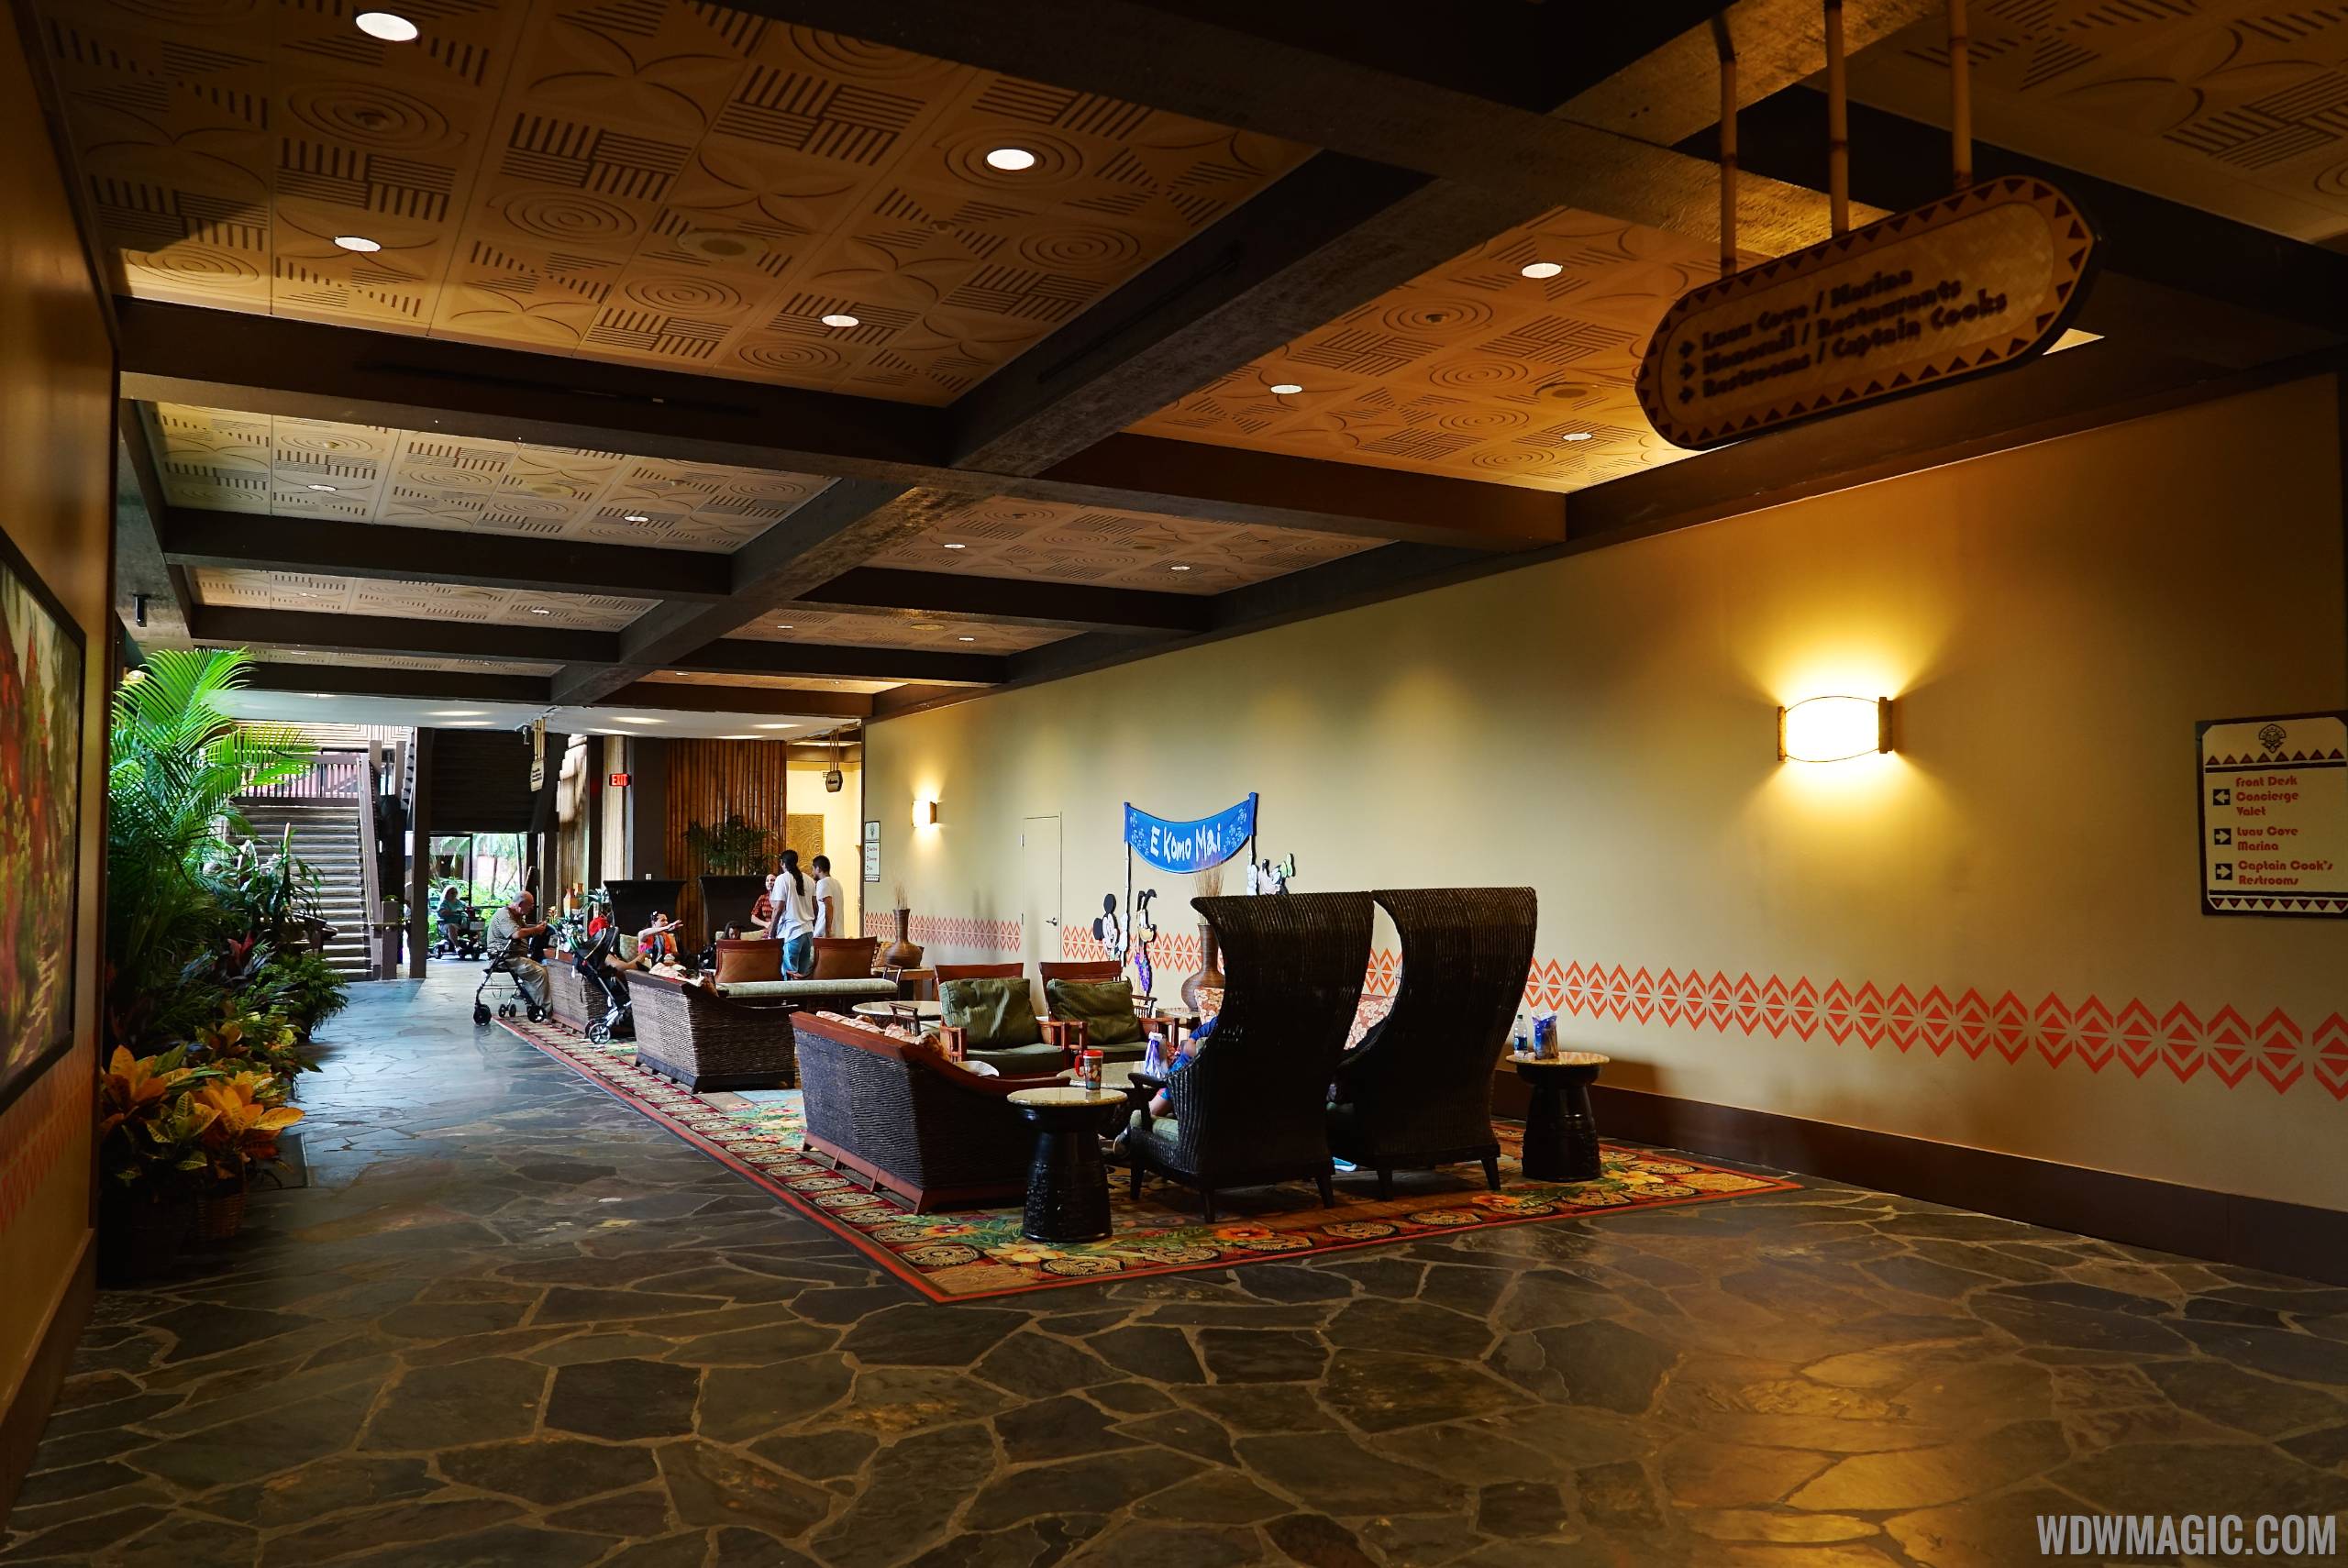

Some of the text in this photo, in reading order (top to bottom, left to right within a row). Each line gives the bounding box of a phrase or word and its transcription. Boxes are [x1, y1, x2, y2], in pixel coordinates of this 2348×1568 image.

[1818, 280, 1962, 339] Restaurants
[1702, 320, 1751, 350] Luau
[1758, 304, 1807, 331] Cove
[1833, 317, 1921, 359] Captain
[1931, 288, 2008, 331] Cooks
[612, 774, 628, 786] EXIT
[2235, 775, 2298, 788] Front Desk
[2236, 790, 2299, 803] Concierge
[2236, 805, 2266, 816] Valet
[2237, 825, 2298, 837] Luau Cove
[1149, 823, 1221, 864] E Komo Mai
[2237, 841, 2279, 851] Marina
[2238, 859, 2333, 873] Captain Cook's
[2239, 875, 2298, 886] Restrooms
